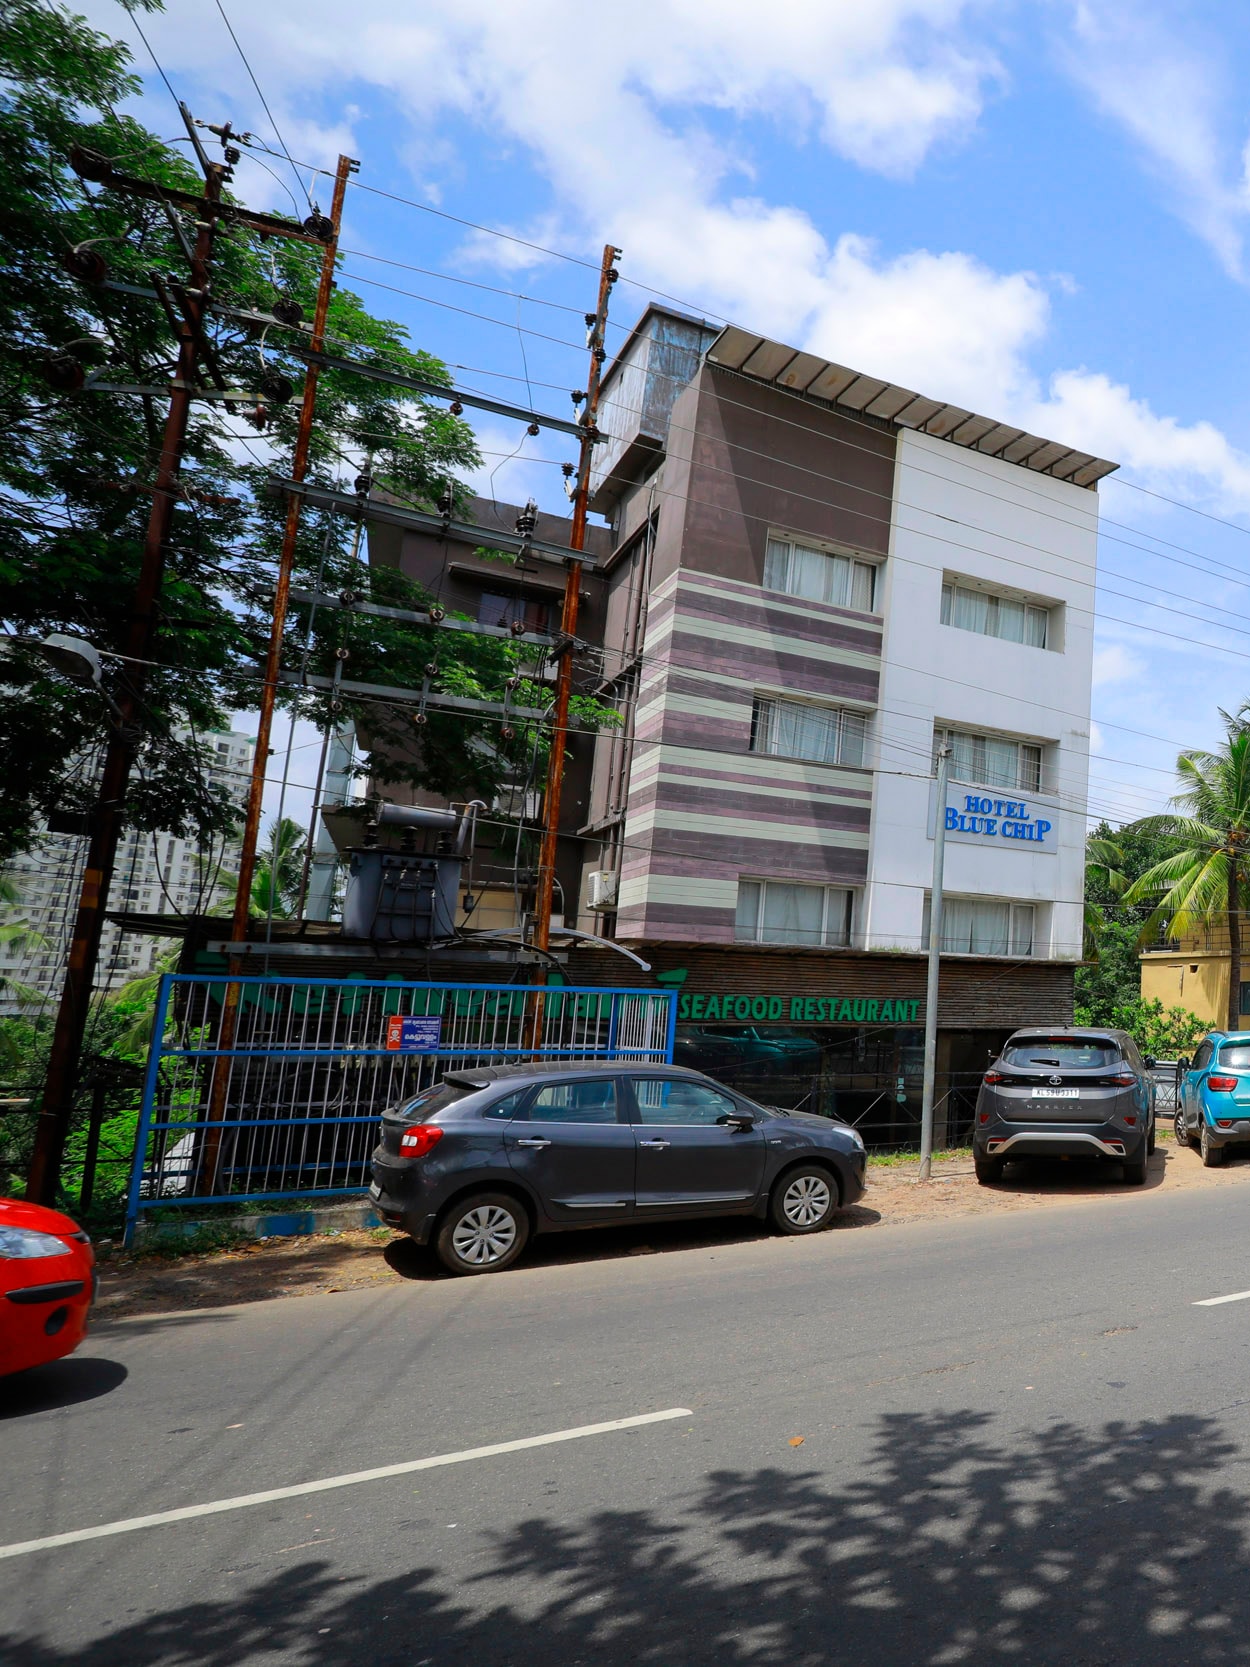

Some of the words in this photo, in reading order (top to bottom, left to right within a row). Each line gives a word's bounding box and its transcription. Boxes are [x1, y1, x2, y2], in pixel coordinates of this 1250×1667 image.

[965, 795, 1030, 820] HOTEL
[945, 807, 997, 836] BLUE
[1002, 819, 1052, 842] CHIP
[679, 994, 783, 1020] SEAFOOD
[790, 997, 920, 1022] RESTAURANT
